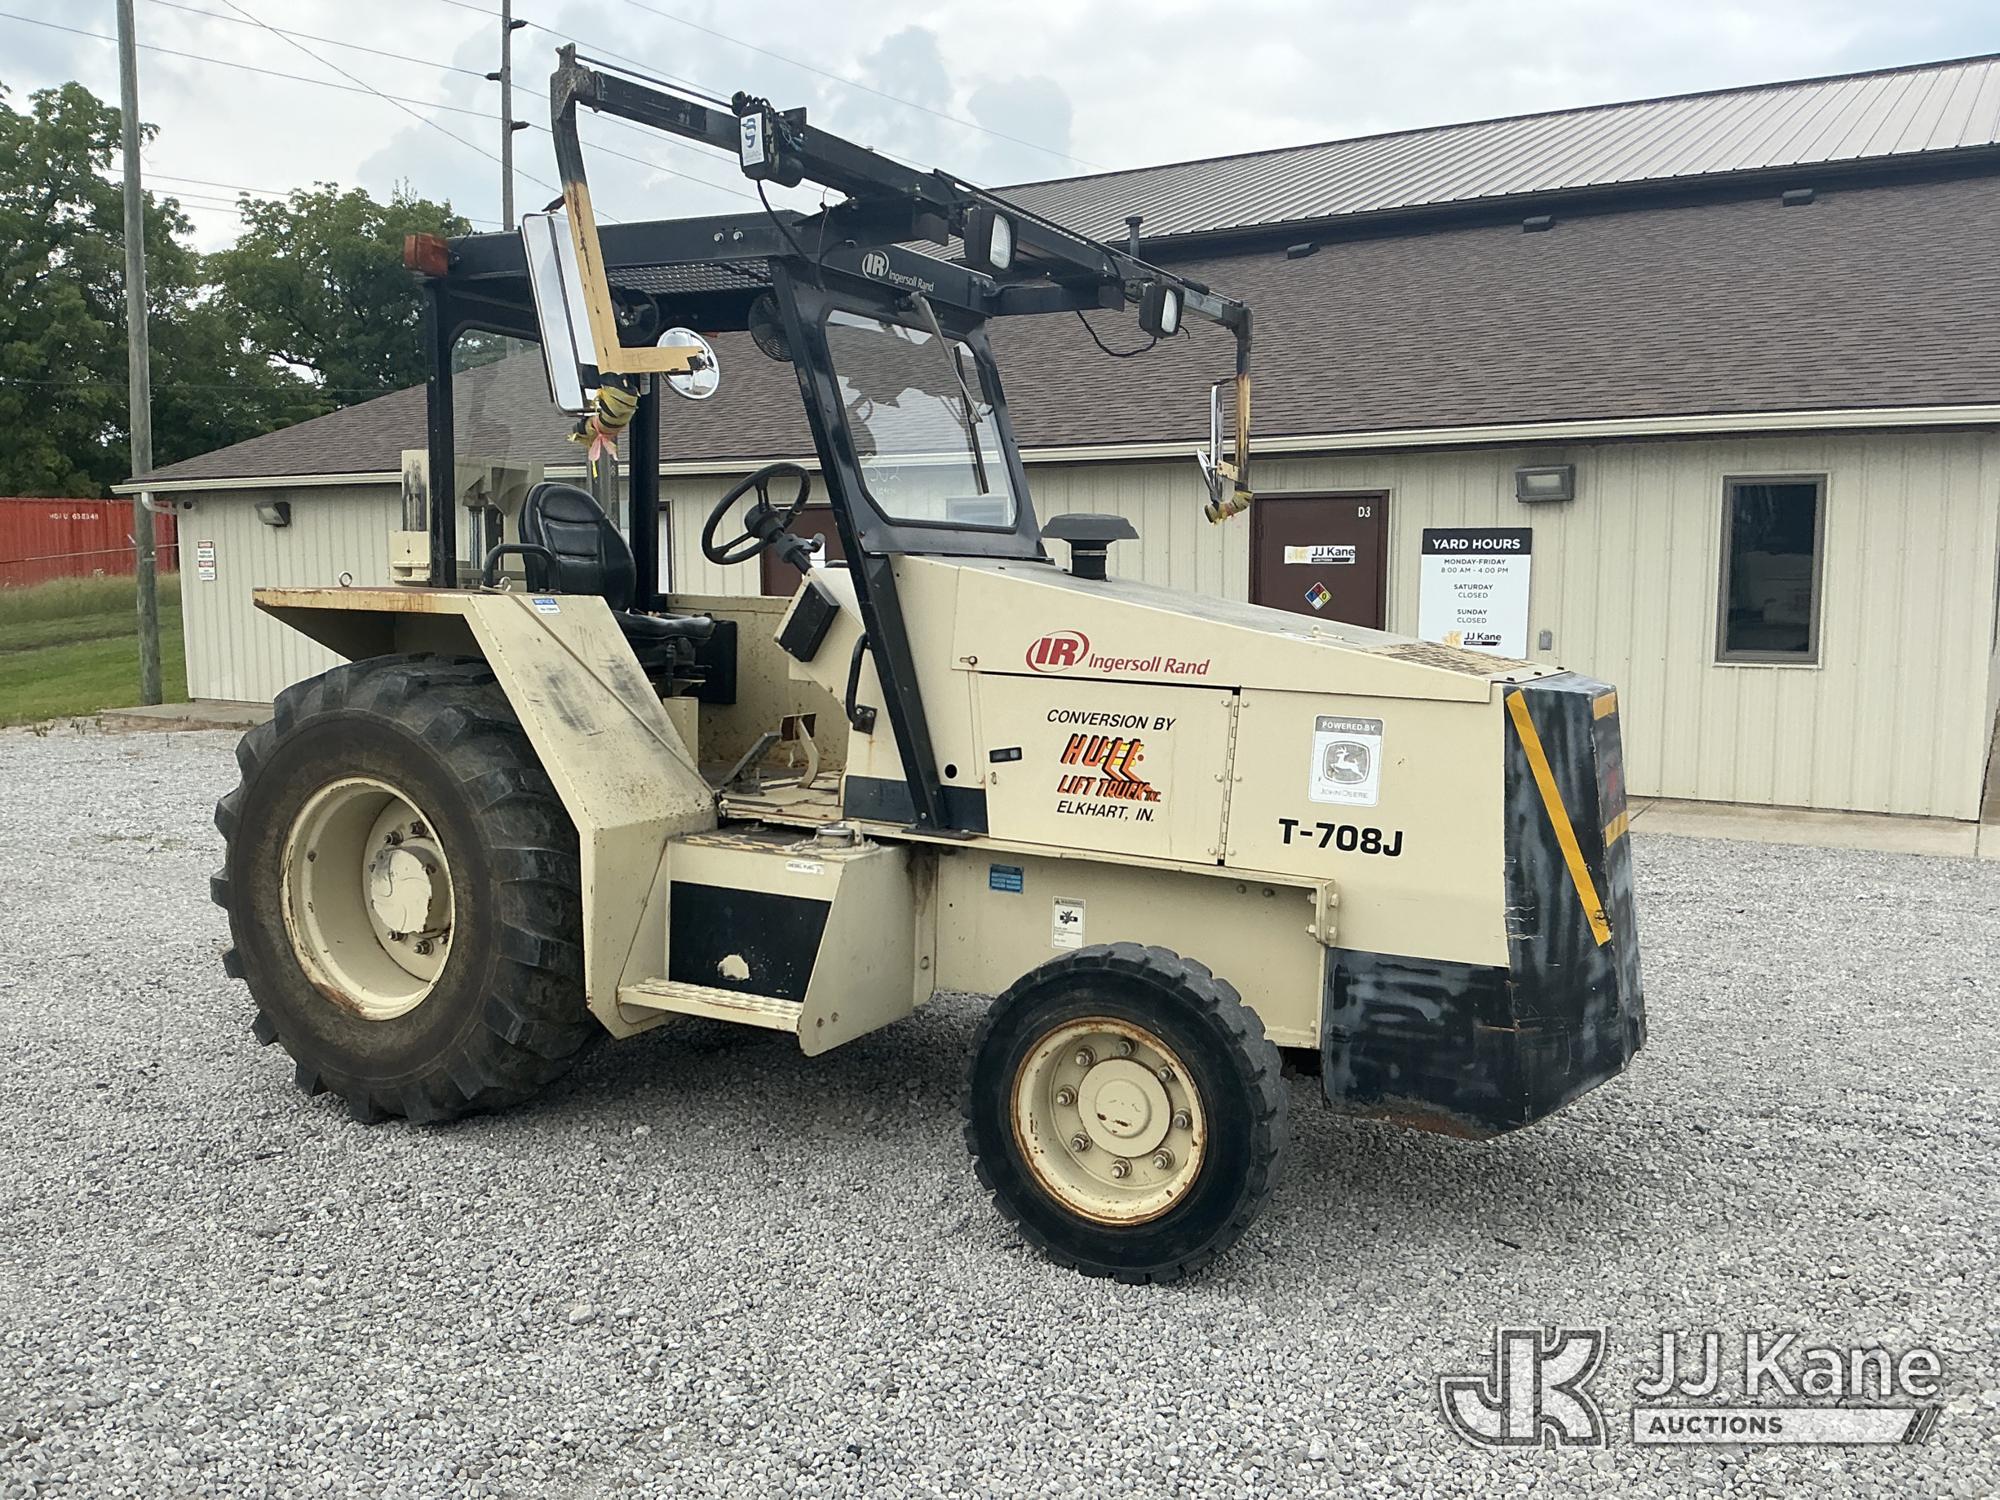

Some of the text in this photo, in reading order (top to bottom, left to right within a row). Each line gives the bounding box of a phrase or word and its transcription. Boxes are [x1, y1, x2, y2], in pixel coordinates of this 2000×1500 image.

[865, 253, 935, 292] IR Ingersoll Rand
[1358, 506, 1371, 518] D3
[1433, 538, 1521, 550] YARD HOURS
[1312, 547, 1325, 557] JJ
[1326, 546, 1356, 557] Kane
[1453, 583, 1494, 591] SATURDAY
[1457, 591, 1489, 599] CLOSED
[1464, 631, 1475, 641] JJ
[1476, 631, 1502, 641] Kane
[1033, 635, 1211, 675] IR Ingersoll Rand
[1047, 709, 1177, 731] CONVERSION BY
[1321, 721, 1377, 732] POWERED BY
[1057, 774, 1097, 796] LIFT
[1095, 778, 1150, 801] TRUCK
[1320, 787, 1369, 799] JOHN DEERE
[1056, 800, 1155, 822] ELKHART, IN.
[1278, 817, 1404, 858] T-708J
